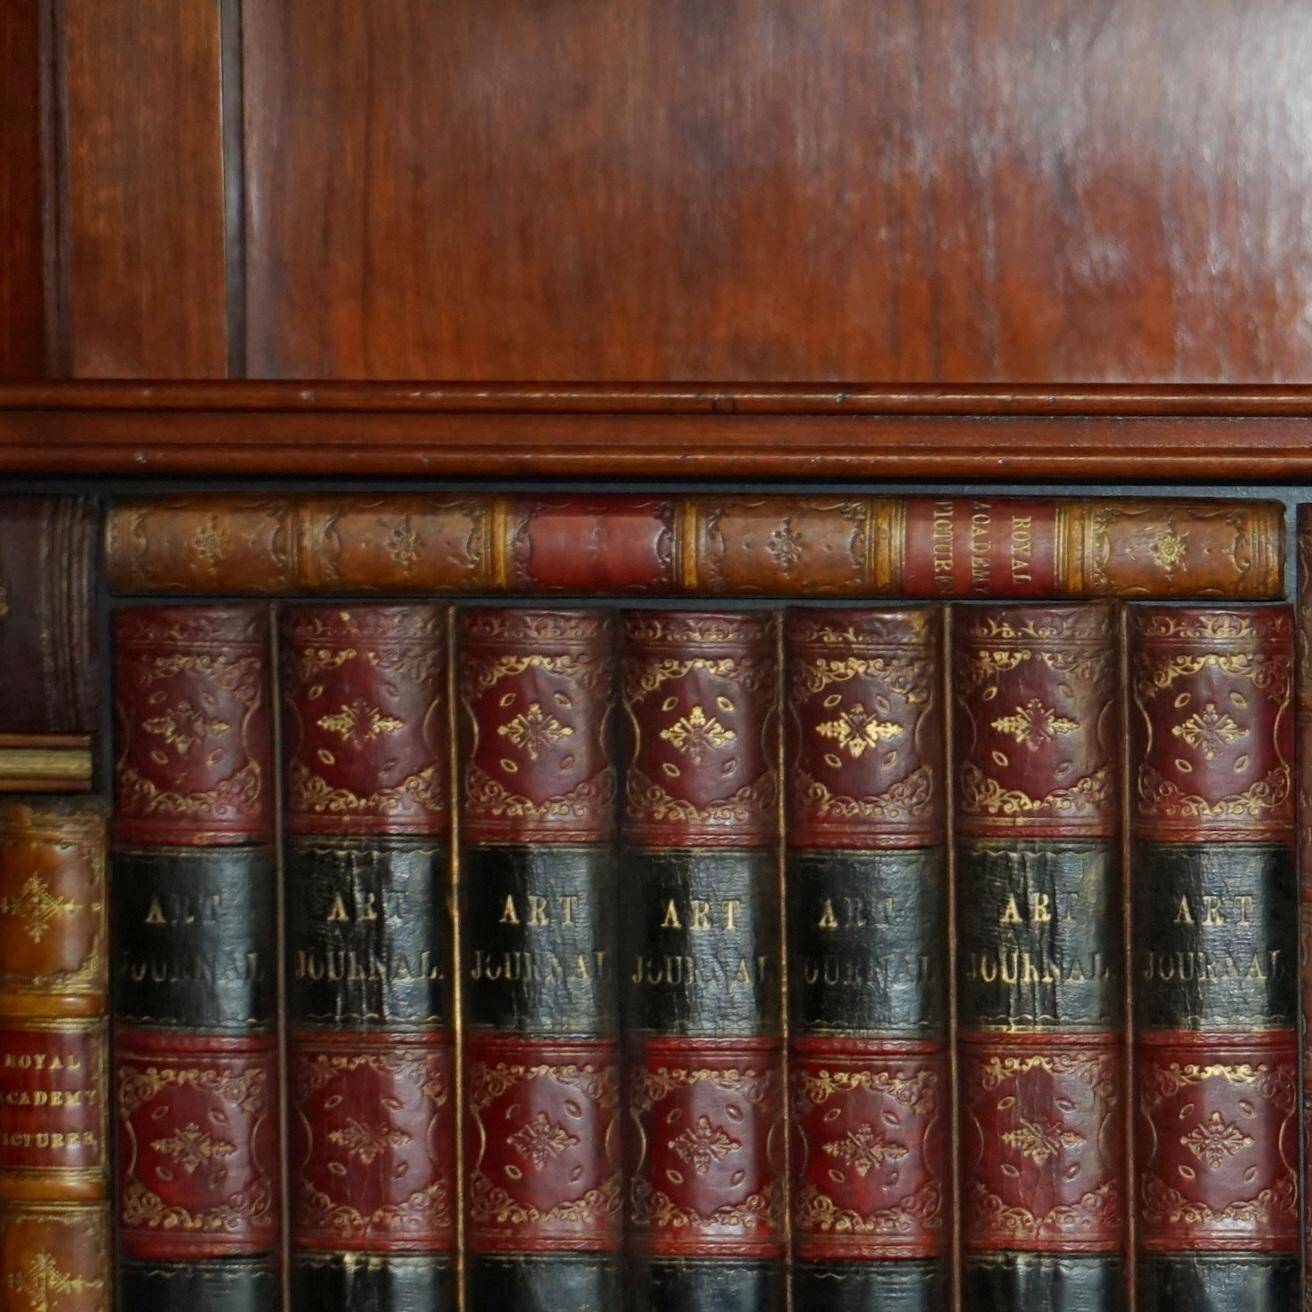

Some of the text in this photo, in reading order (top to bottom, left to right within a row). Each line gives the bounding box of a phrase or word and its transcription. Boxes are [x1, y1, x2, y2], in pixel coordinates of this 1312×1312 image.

[932, 501, 955, 598] PICTURE
[1011, 515, 1032, 584] ROYAL
[327, 892, 406, 923] ART
[499, 893, 580, 927] ART
[660, 899, 740, 931] ART
[1000, 892, 1080, 924] ART
[1173, 893, 1253, 925] ART
[4, 1053, 81, 1071] ROYAL
[0, 1089, 97, 1107] CADEMY
[0, 1130, 98, 1149] ICTURES
